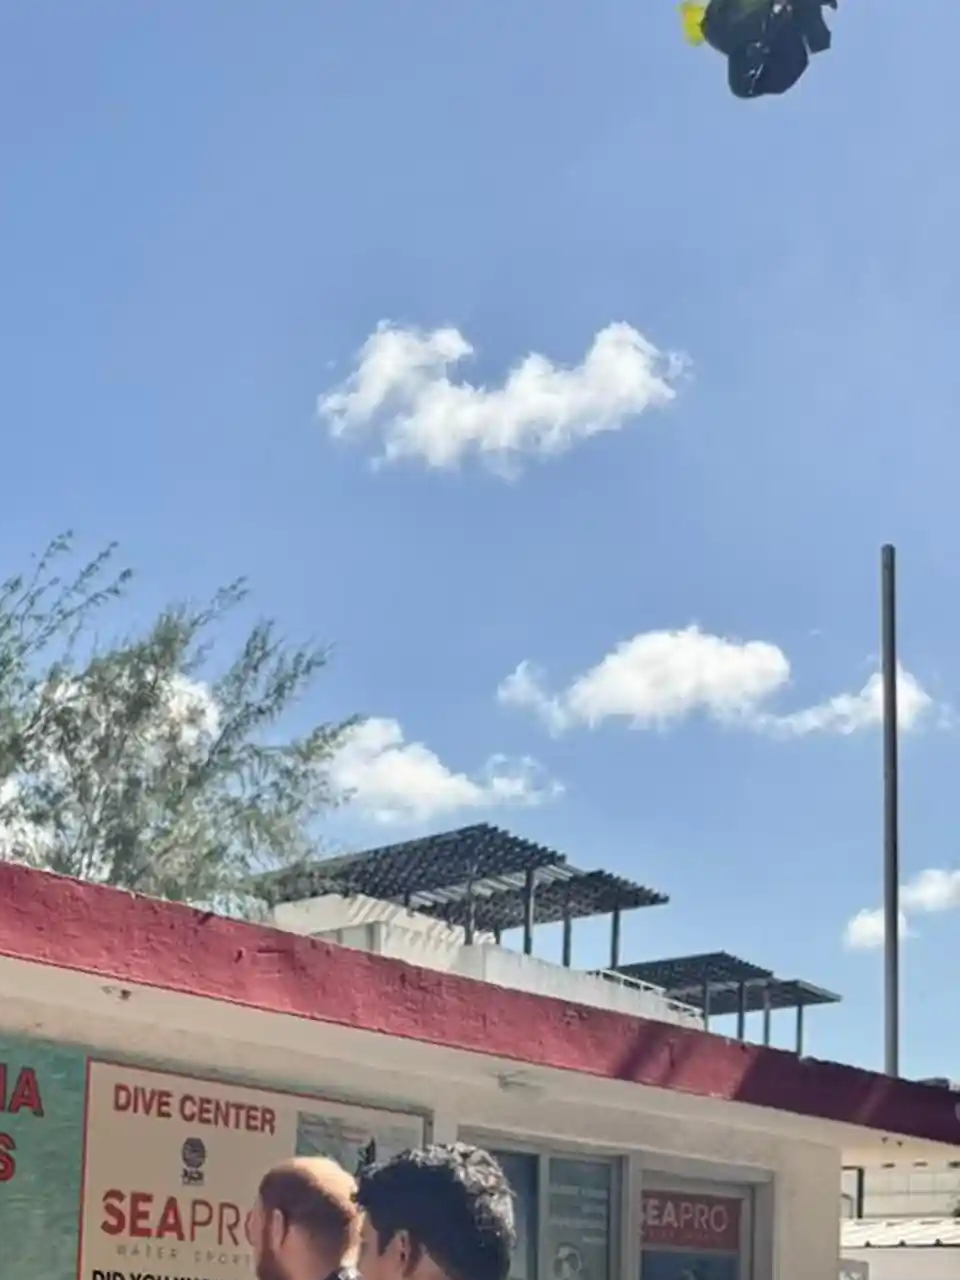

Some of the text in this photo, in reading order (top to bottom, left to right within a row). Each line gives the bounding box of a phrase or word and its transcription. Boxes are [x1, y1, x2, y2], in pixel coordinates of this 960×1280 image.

[113, 1083, 173, 1119] DIVE
[180, 1095, 277, 1136] CENTER
[117, 1244, 254, 1267] WATER SPORT
